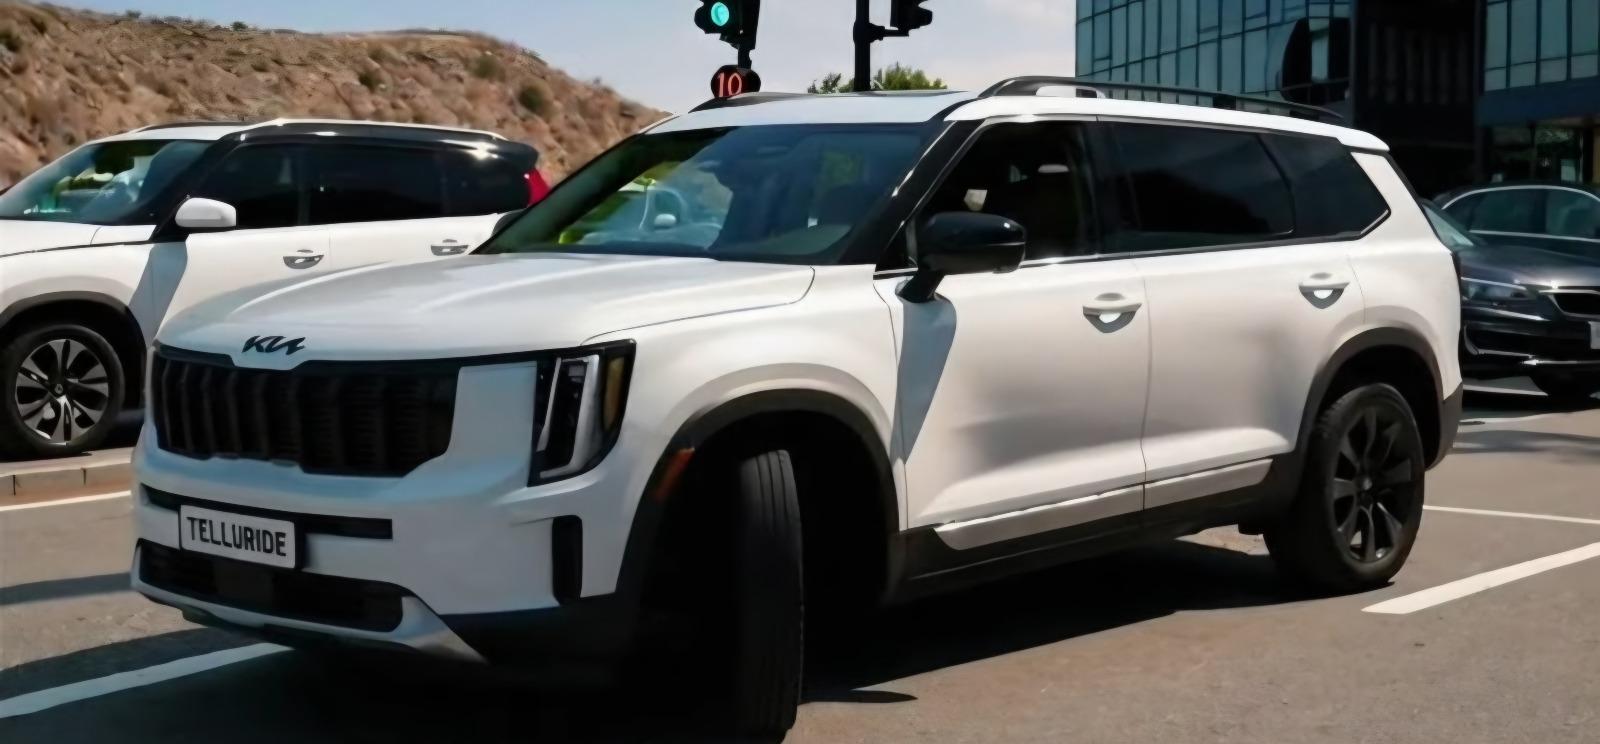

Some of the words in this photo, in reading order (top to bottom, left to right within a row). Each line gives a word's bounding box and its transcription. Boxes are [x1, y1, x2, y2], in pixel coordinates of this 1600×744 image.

[717, 72, 742, 97] 10
[241, 335, 306, 355] KIA
[186, 516, 287, 557] TELLURIDE
